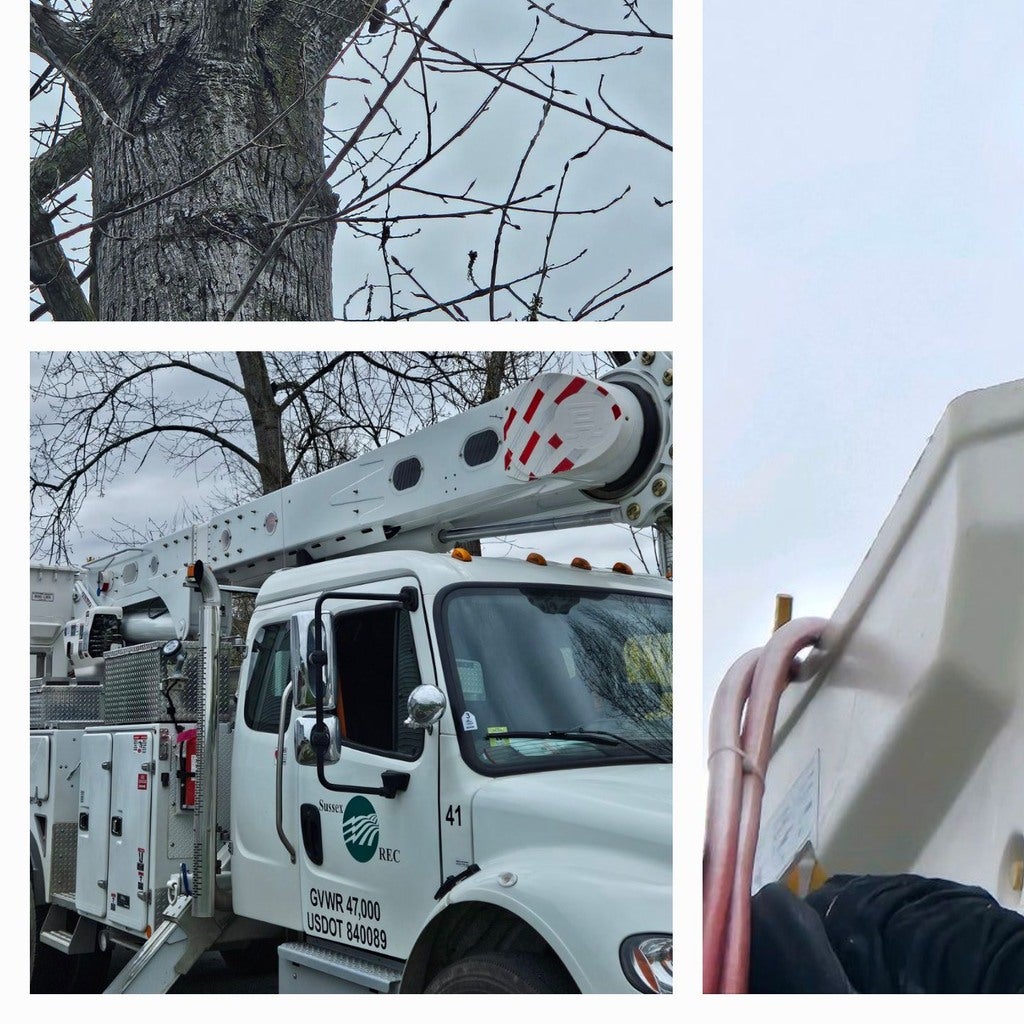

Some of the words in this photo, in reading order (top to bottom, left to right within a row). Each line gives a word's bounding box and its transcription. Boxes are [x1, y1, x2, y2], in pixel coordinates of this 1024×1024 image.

[319, 799, 344, 814] Sussex
[446, 805, 461, 826] 41
[379, 847, 401, 863] REC
[310, 888, 344, 914] GVWR
[346, 896, 381, 922] 47,000
[307, 912, 343, 938] USDOT
[346, 921, 387, 950] 840089
